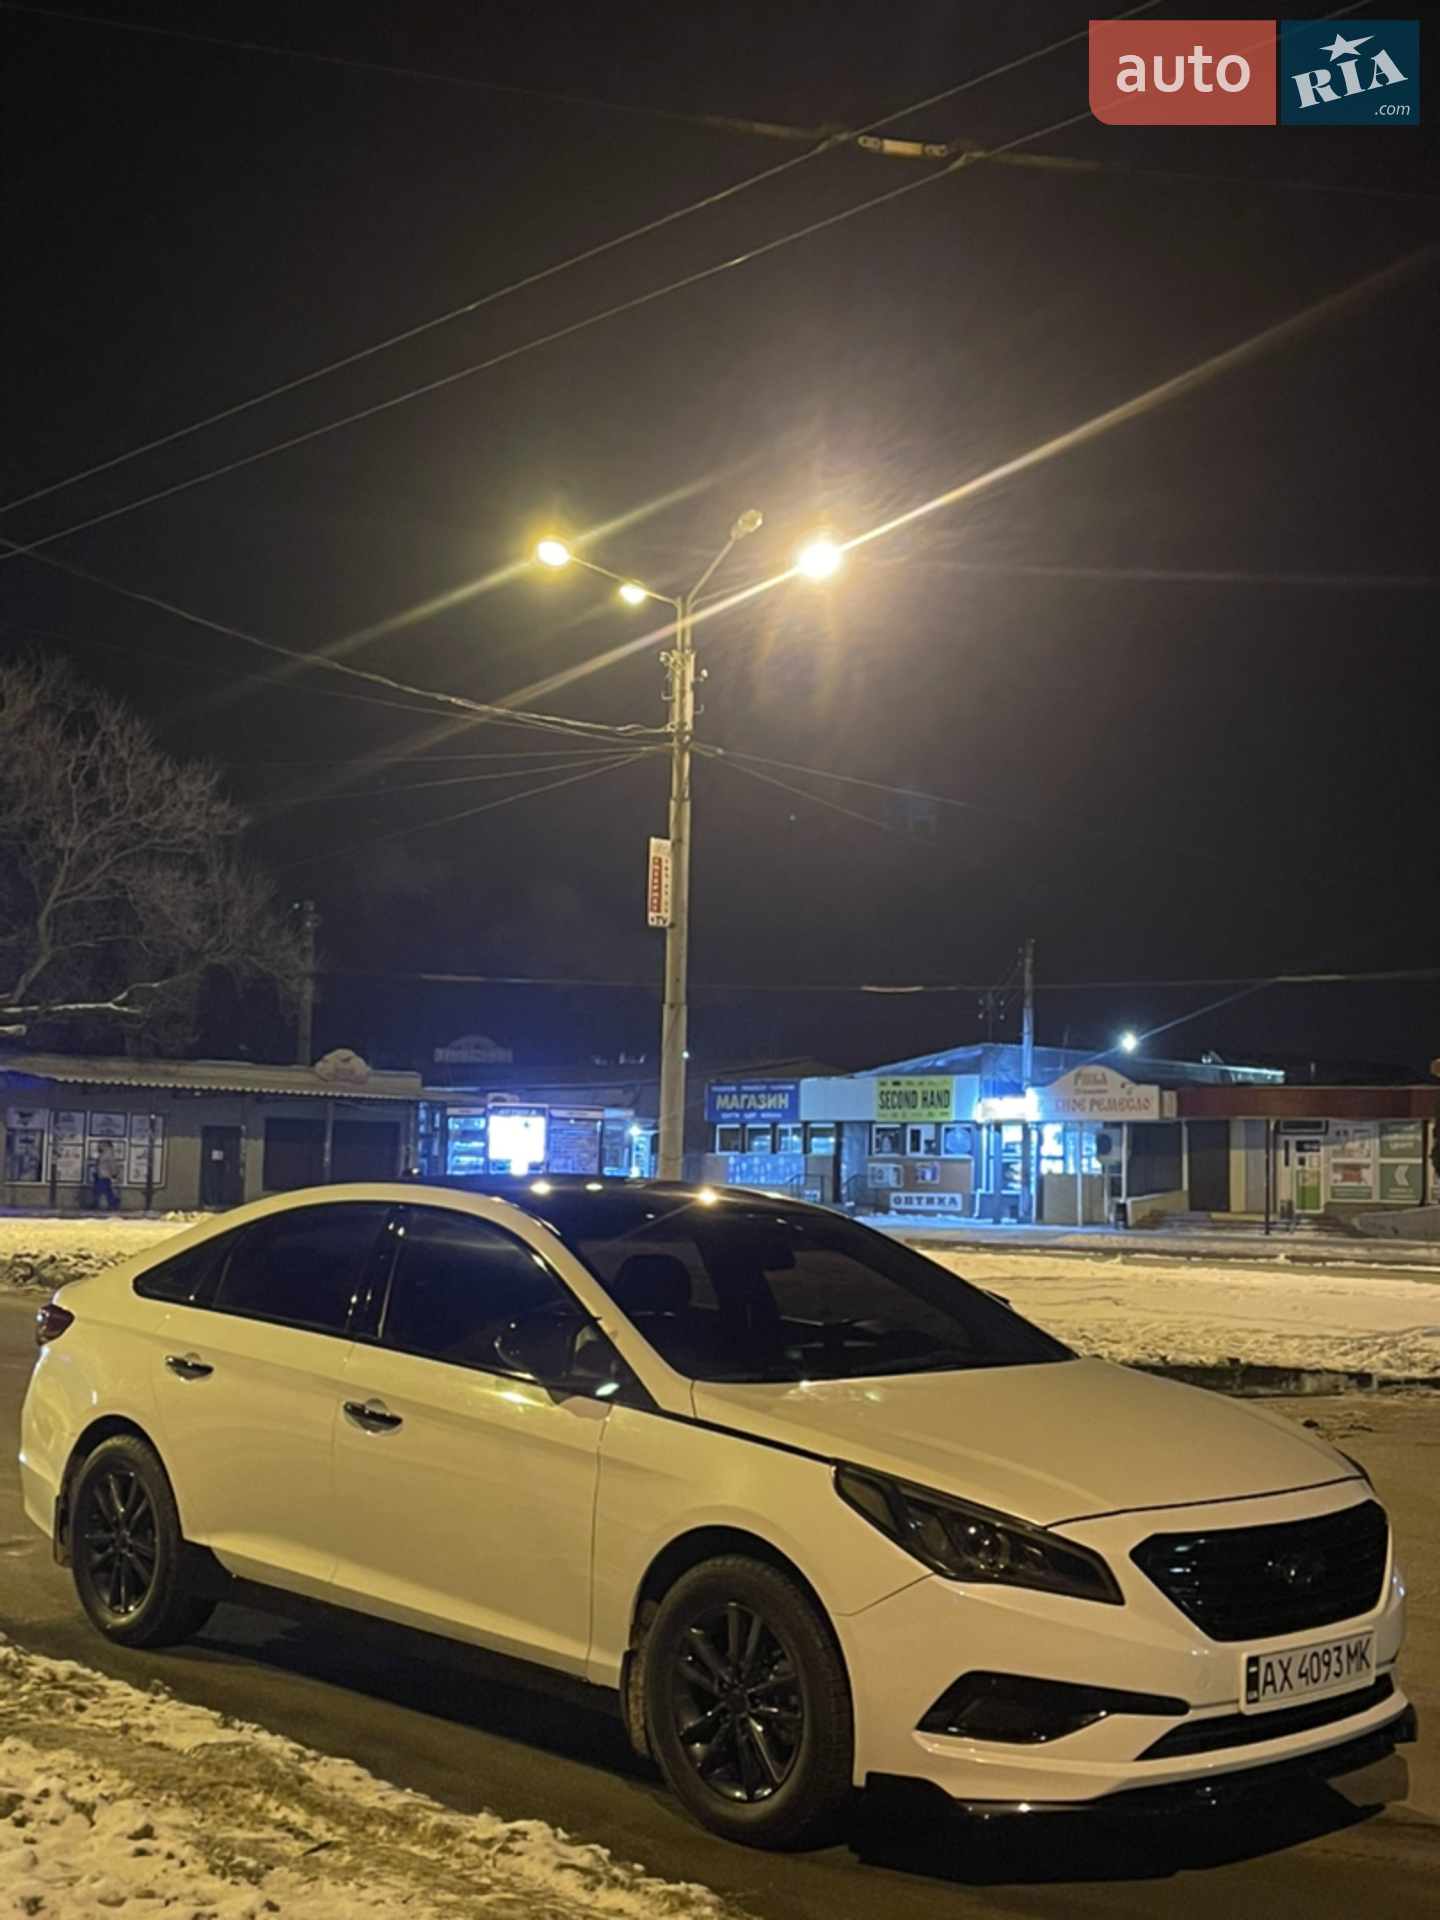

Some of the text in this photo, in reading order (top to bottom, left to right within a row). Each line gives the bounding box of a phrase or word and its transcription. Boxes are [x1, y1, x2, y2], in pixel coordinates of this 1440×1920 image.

[716, 1094, 789, 1110] МАГАЗИН
[879, 1089, 950, 1110] SECOND HAND
[893, 1196, 958, 1206] ОПТИКА
[1262, 1637, 1371, 1696] AX 4093 MK
